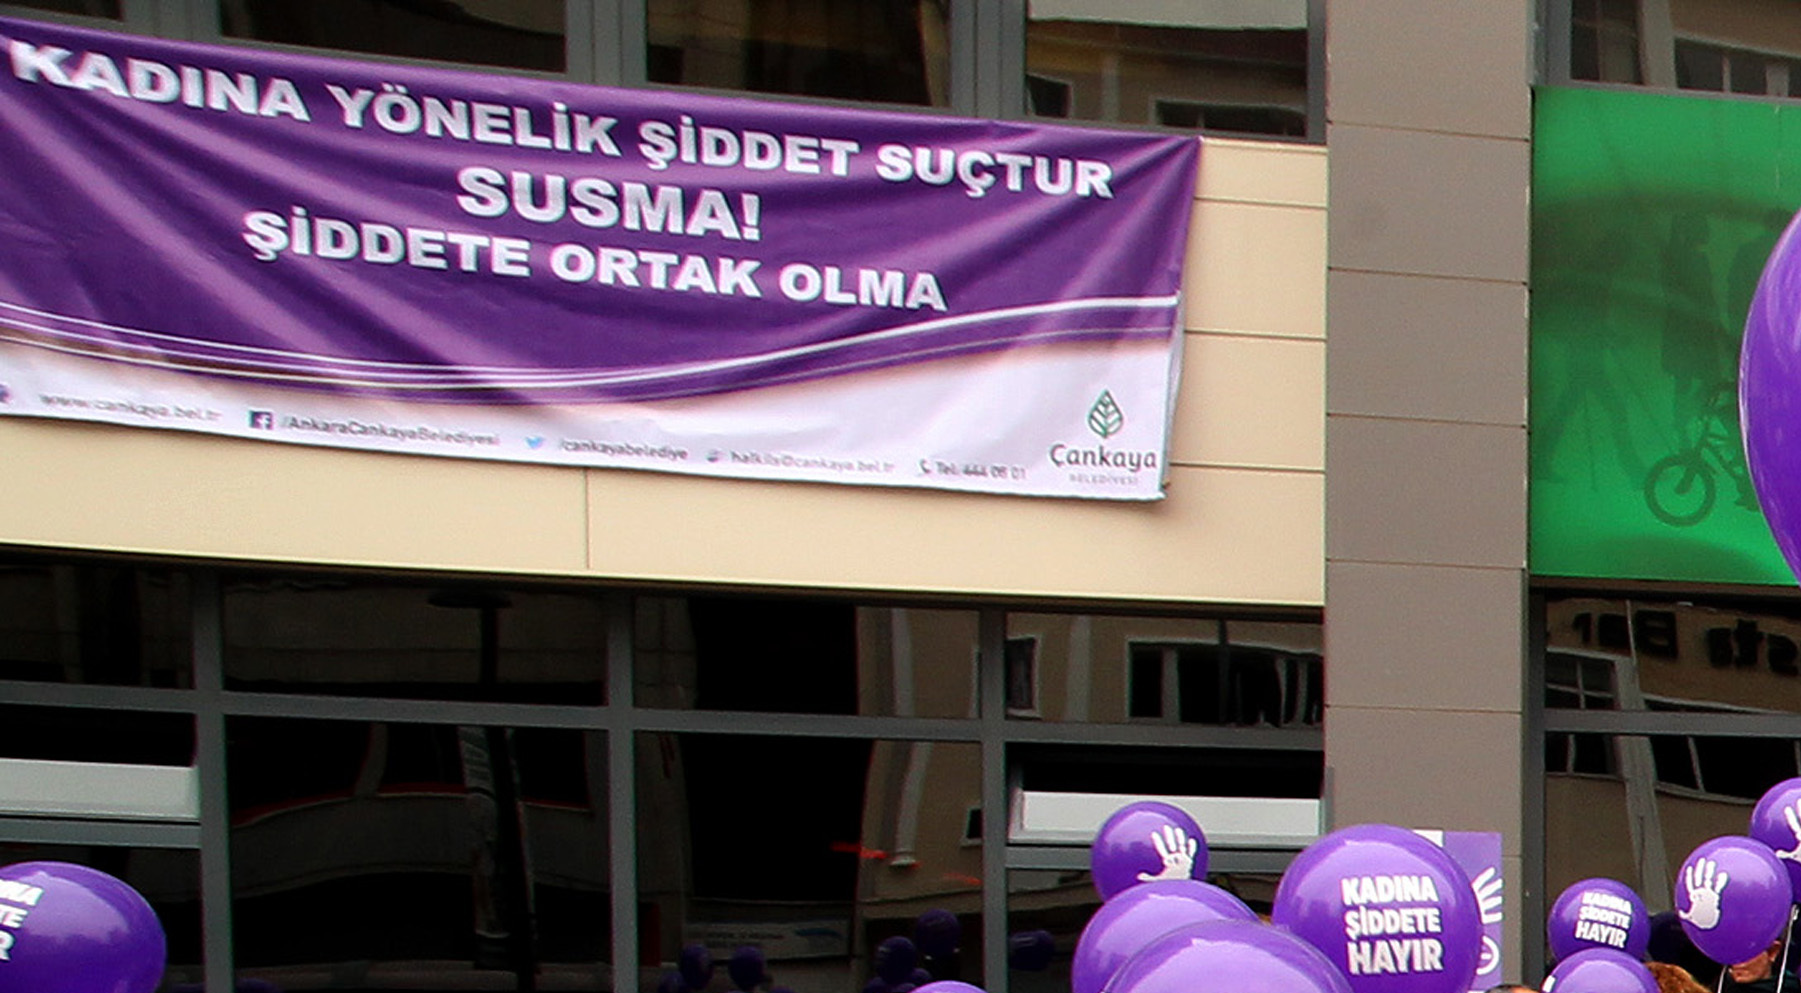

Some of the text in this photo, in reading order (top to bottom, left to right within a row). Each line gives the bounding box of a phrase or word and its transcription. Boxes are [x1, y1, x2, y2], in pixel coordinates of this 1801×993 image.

[9, 38, 1114, 199] KADINA YÖNELİK ŞİDDET SUÇTUR
[456, 166, 761, 241] SUSMA!
[241, 206, 947, 311] ŞİDDETE ORTAK OLMA
[1048, 444, 1158, 474] Çankaya
[1340, 874, 1439, 906] KADINA
[1344, 907, 1443, 940] ŞİDDETE
[1575, 920, 1627, 949] HAYIR
[1347, 939, 1444, 975] HAYIR
